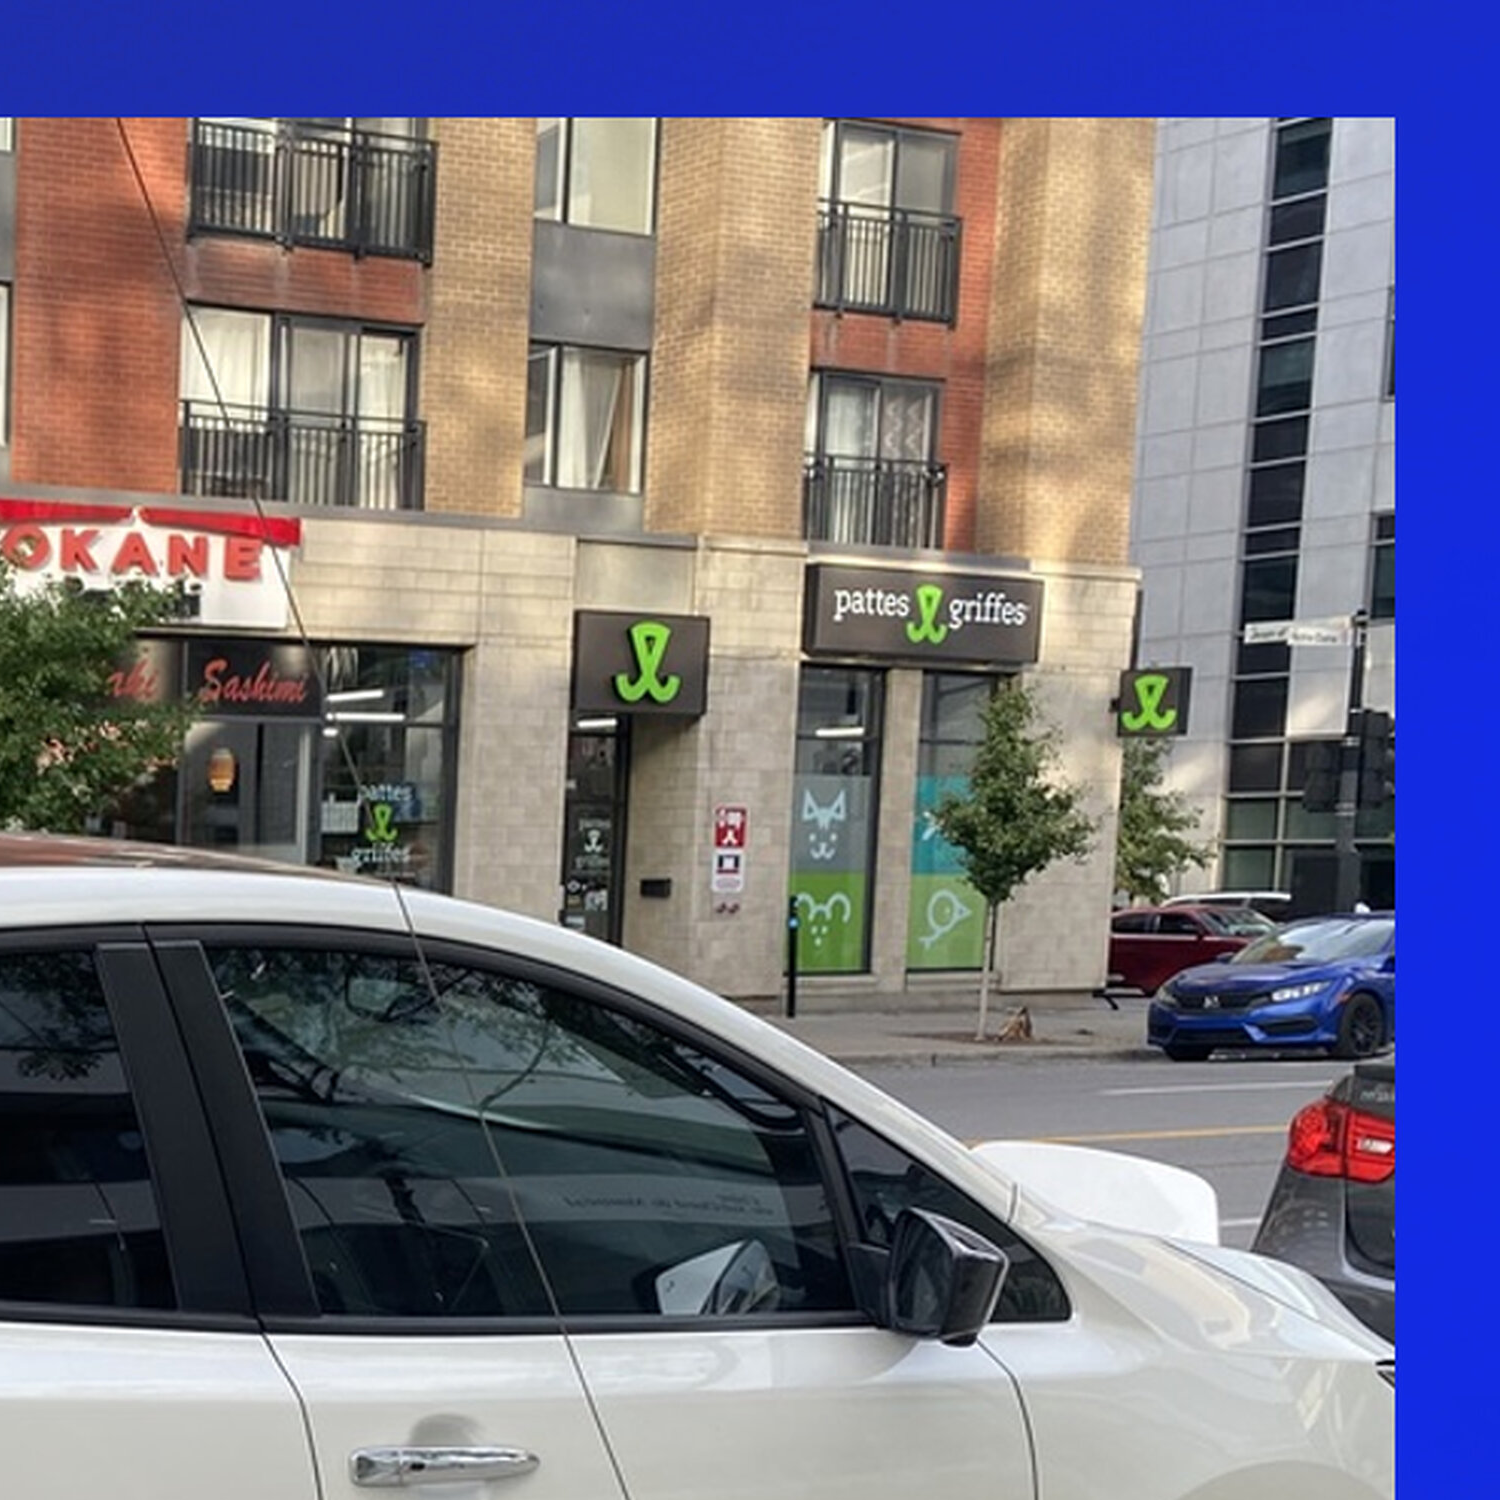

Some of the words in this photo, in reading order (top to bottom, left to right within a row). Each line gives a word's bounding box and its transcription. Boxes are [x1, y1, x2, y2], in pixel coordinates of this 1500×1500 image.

[1, 524, 263, 581] OKANE
[833, 588, 910, 621] pattes
[948, 591, 1028, 629] griffes
[200, 657, 309, 703] Sashimi
